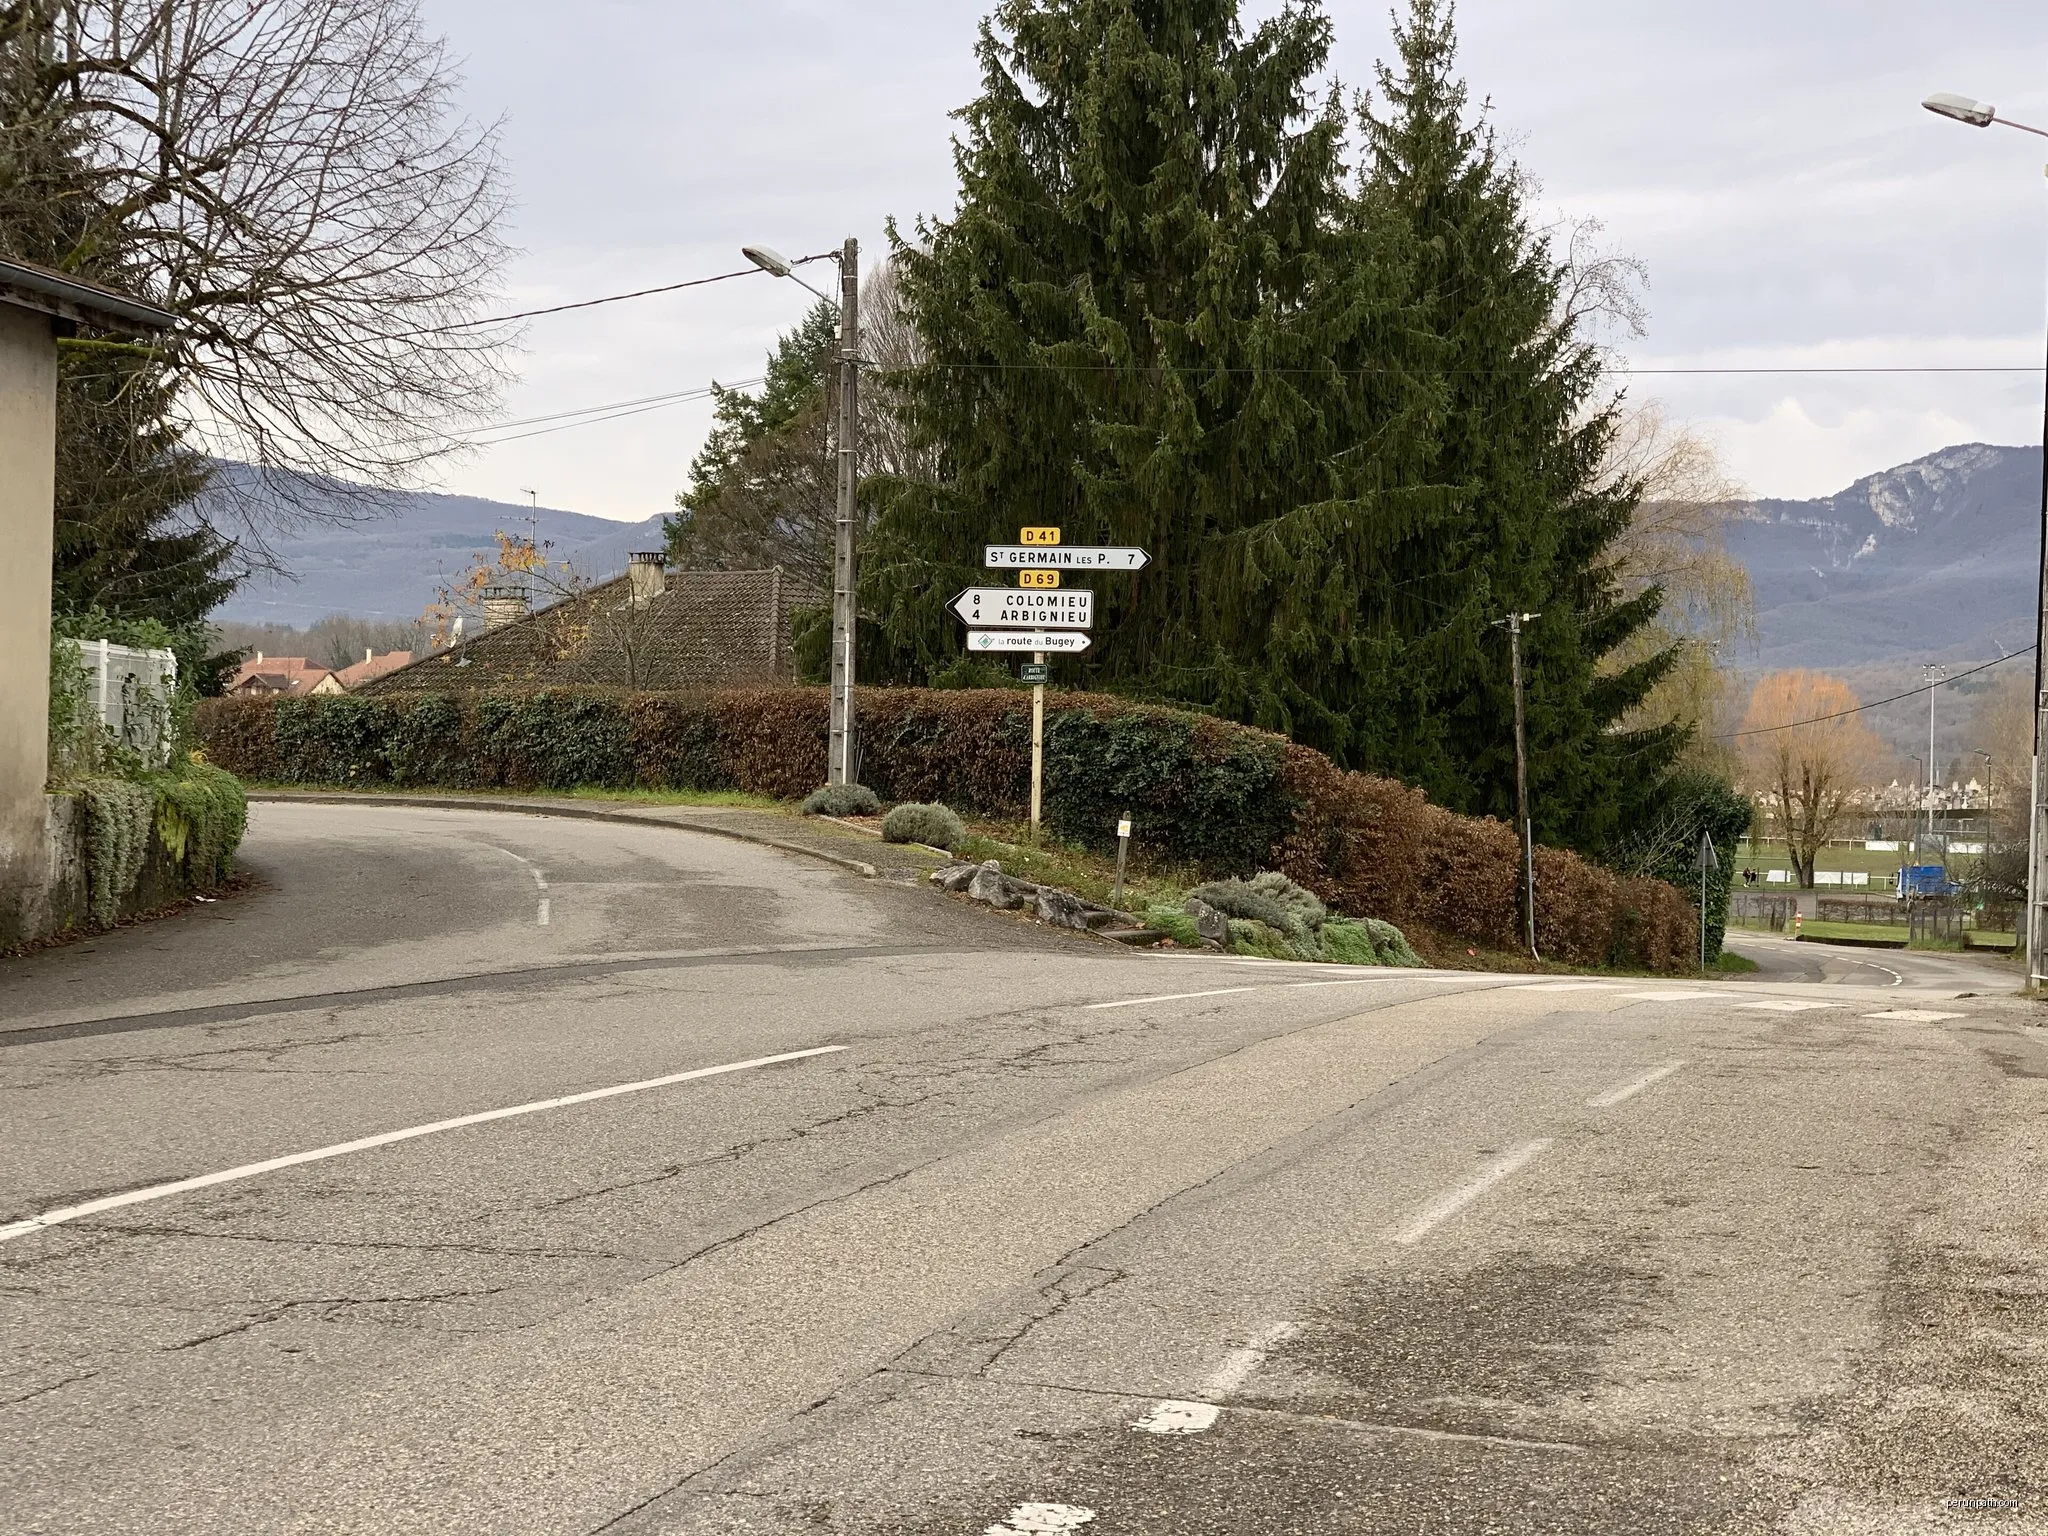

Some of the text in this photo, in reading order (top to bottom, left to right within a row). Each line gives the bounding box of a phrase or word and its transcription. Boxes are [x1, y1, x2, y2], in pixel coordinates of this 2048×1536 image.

[1026, 531, 1055, 541] D 41
[1009, 552, 1072, 563] GERMAIN
[1098, 554, 1110, 564] P.
[1128, 554, 1135, 565] 7
[1024, 574, 1054, 584] D 69
[973, 595, 1087, 607] 8 COLOMIEU
[972, 609, 1087, 622] 4 ARBIGNIEU
[1007, 637, 1032, 645] route
[1045, 637, 1075, 647] Bugey
